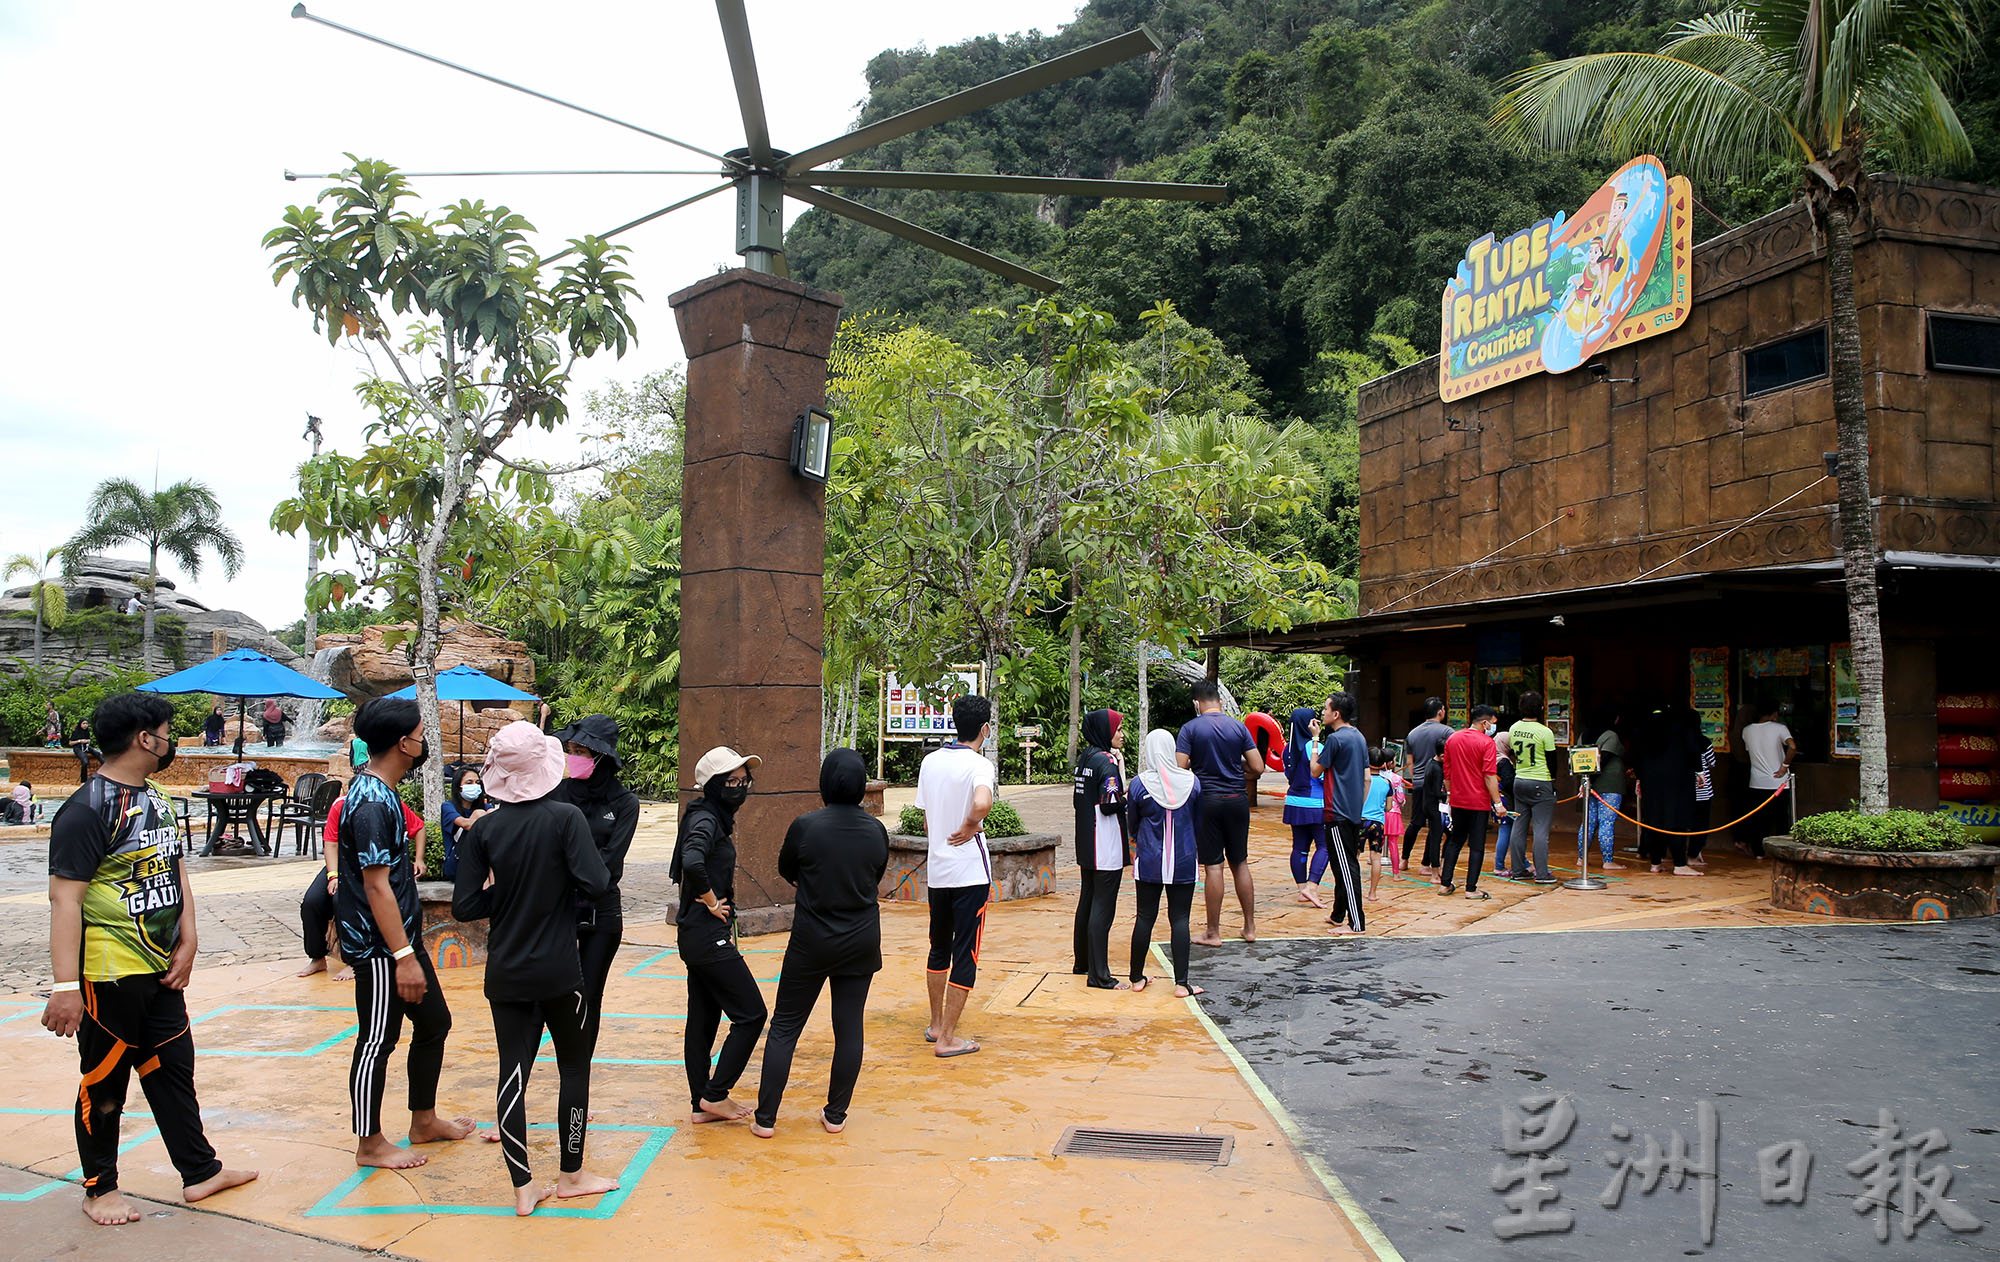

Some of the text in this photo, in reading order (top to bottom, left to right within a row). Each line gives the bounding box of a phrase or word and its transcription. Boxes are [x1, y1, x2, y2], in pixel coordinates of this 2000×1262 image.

[1468, 223, 1550, 295] TUBE
[1453, 271, 1551, 341] RENTAL
[1466, 325, 1535, 367] Counter
[139, 826, 177, 849] SILVER
[142, 872, 171, 890] THE
